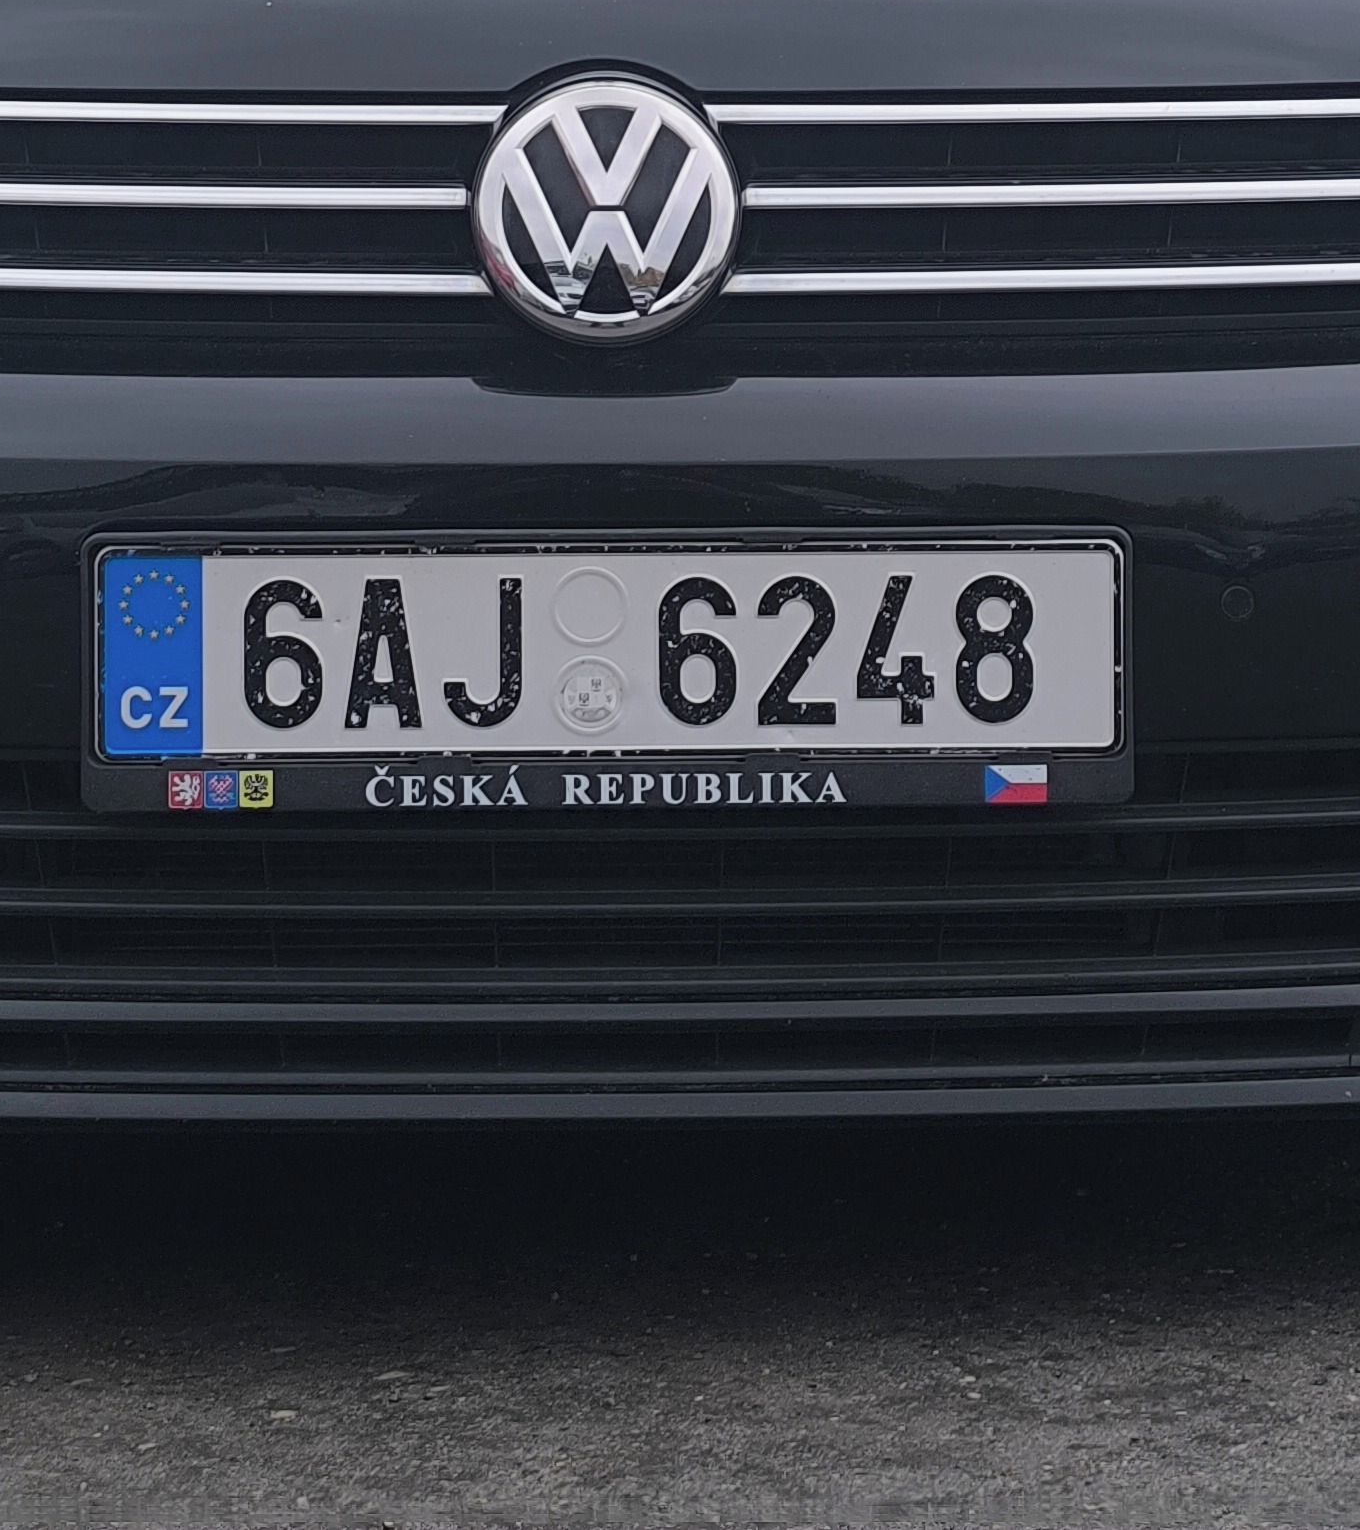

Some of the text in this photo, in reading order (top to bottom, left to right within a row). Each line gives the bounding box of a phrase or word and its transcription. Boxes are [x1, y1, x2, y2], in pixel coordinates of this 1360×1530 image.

[242, 573, 1036, 730] 6AJ 6248
[119, 684, 190, 730] CZ
[363, 763, 849, 808] ČESKÁ REPUBLIKA
